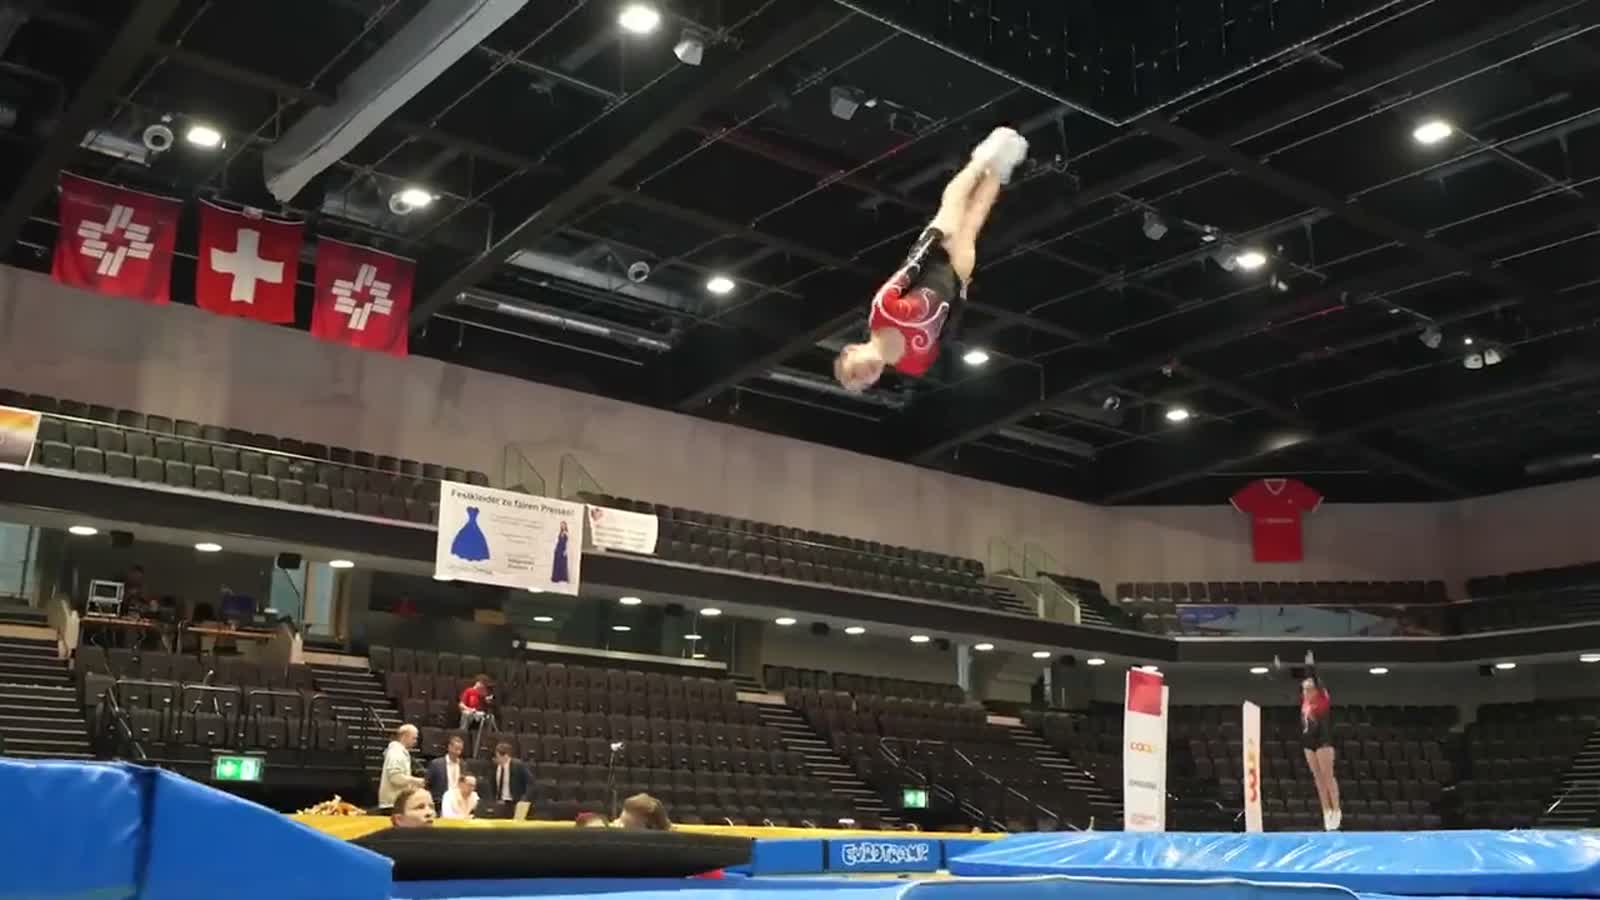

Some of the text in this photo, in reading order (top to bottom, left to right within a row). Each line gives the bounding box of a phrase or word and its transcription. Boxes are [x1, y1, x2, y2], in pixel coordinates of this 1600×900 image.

[502, 499, 513, 507] zu
[514, 499, 540, 512] fairen
[842, 841, 929, 866] EUROTRAMP
